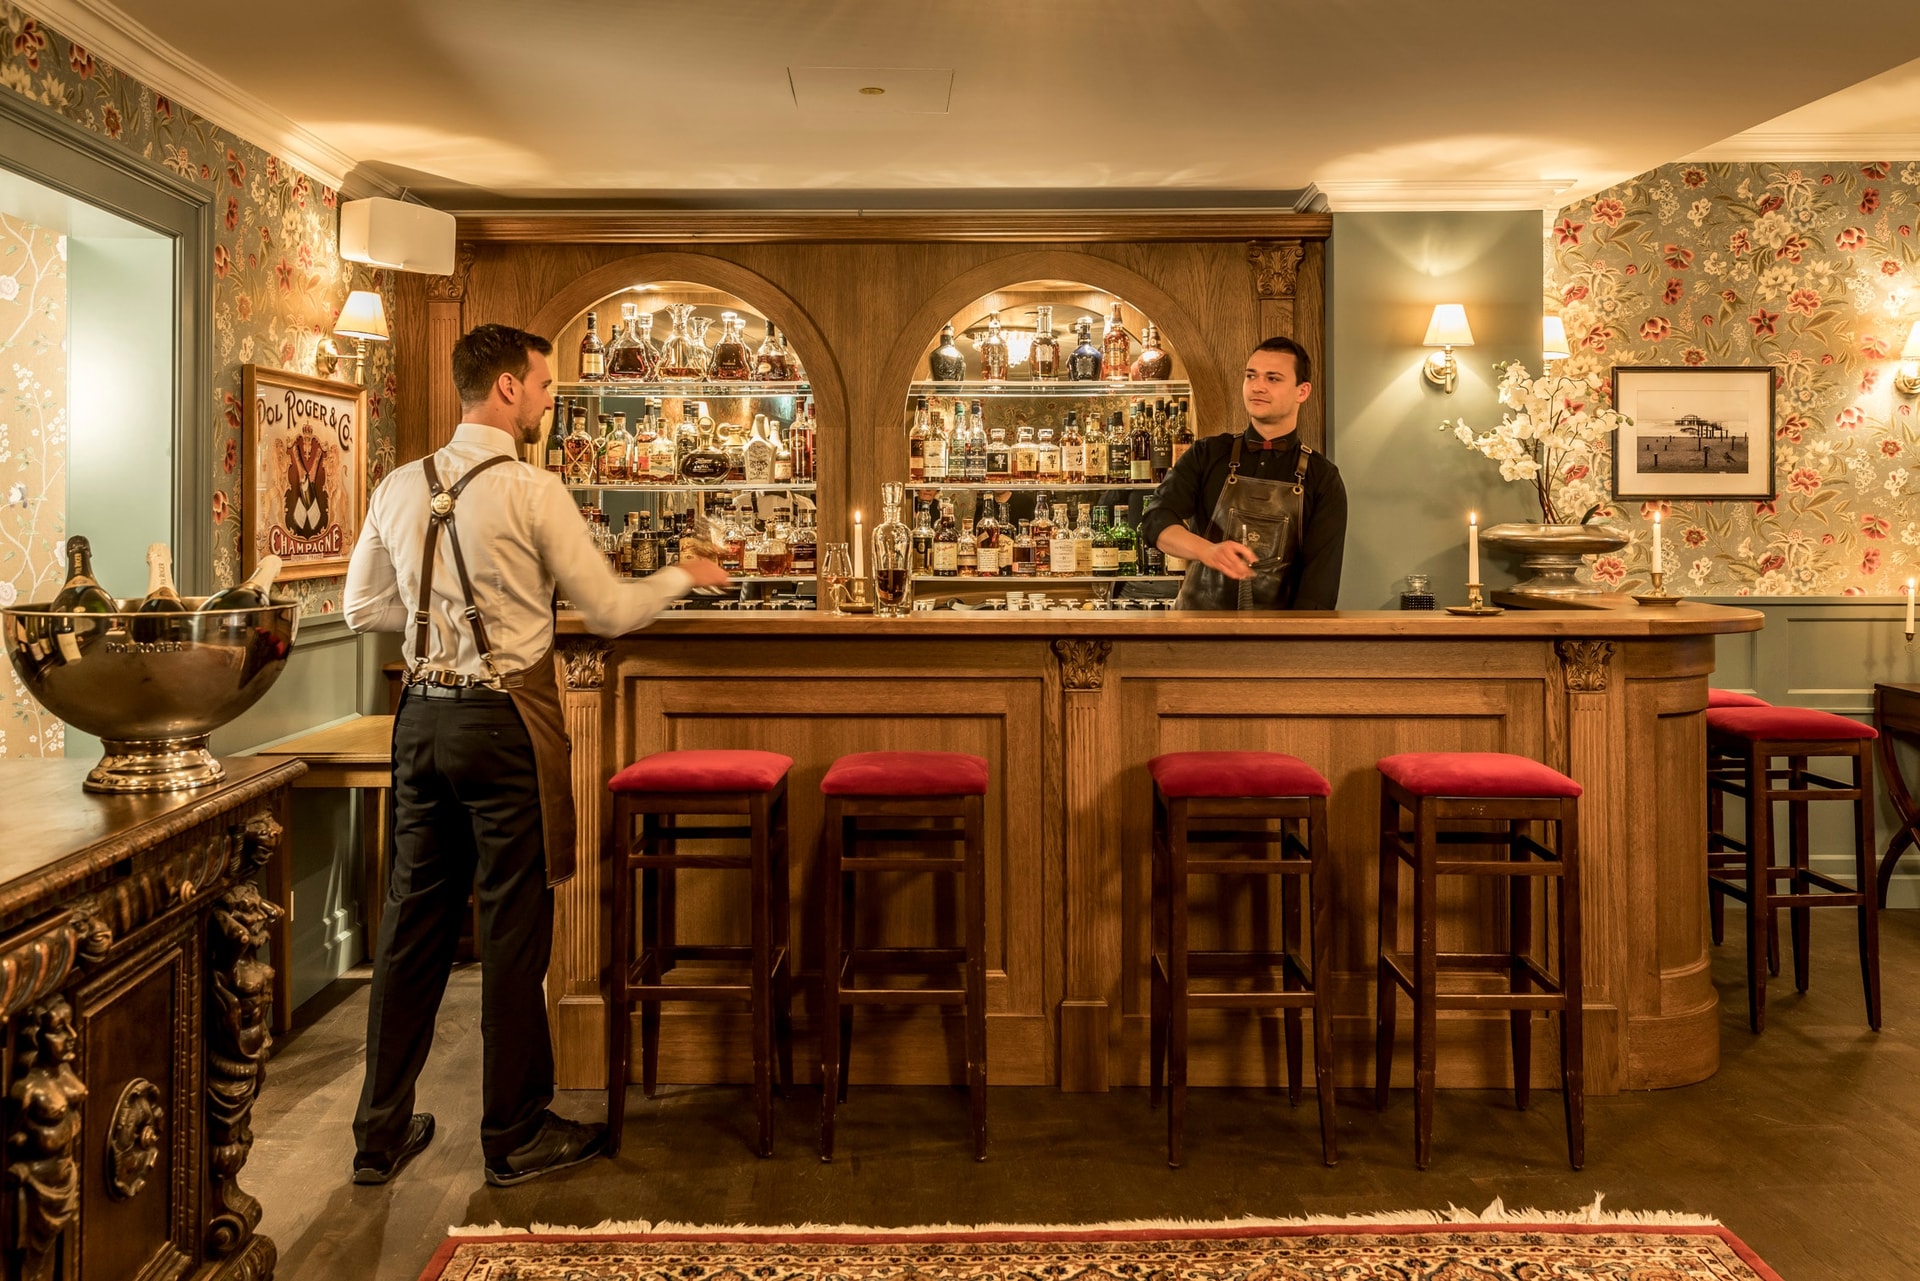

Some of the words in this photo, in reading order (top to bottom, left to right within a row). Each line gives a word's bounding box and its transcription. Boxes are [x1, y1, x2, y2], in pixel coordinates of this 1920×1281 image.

[256, 398, 283, 442] POL
[285, 390, 328, 430] ROGER
[329, 407, 337, 431] &
[271, 527, 340, 555] CHAMPAGNE
[105, 641, 134, 653] POL
[136, 641, 182, 653] ROGER
